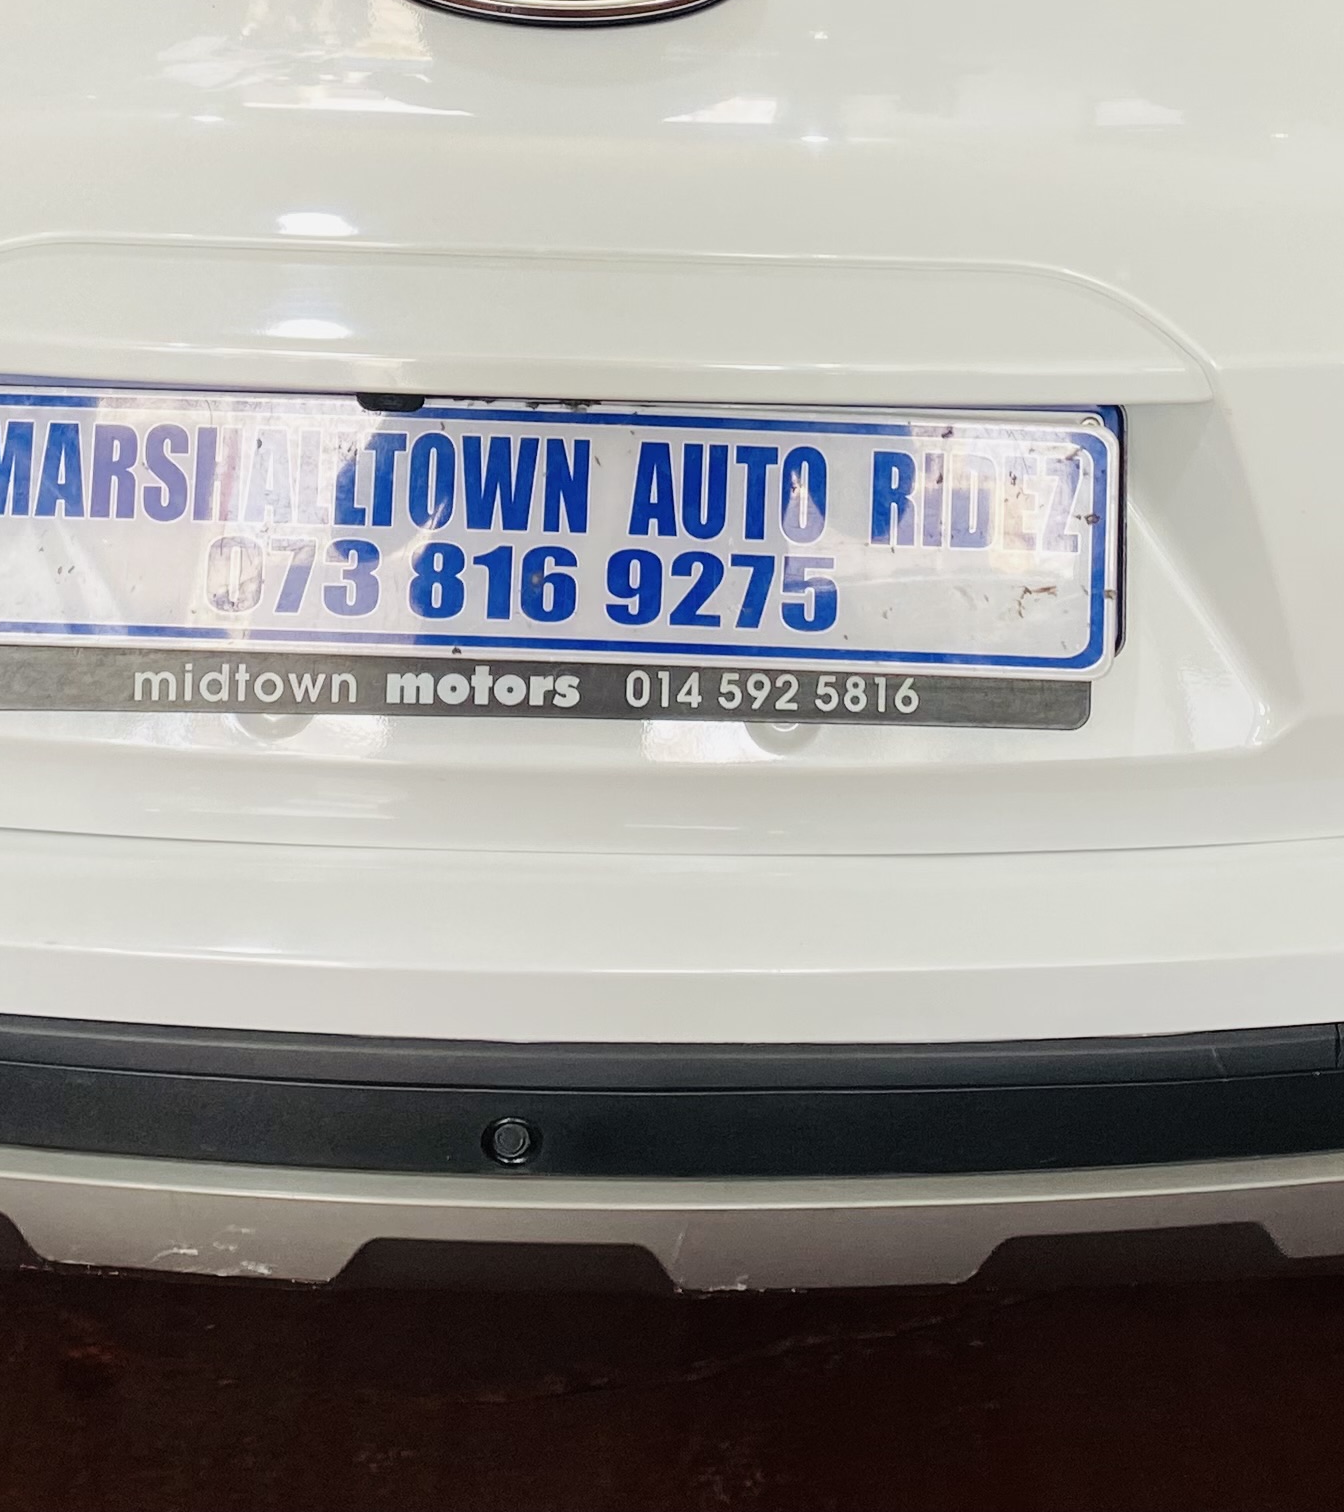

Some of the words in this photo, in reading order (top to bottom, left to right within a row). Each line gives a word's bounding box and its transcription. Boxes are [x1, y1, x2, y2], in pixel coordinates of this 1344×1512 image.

[627, 440, 830, 545] AUTO
[869, 448, 1085, 555] RIDEZ
[206, 535, 382, 618] 073
[408, 539, 579, 624] 816
[604, 546, 840, 635] 9275
[132, 662, 358, 704] midtown
[385, 666, 582, 710] motors
[624, 669, 702, 711] 014
[717, 672, 799, 713] 592
[814, 675, 921, 715] 5816
